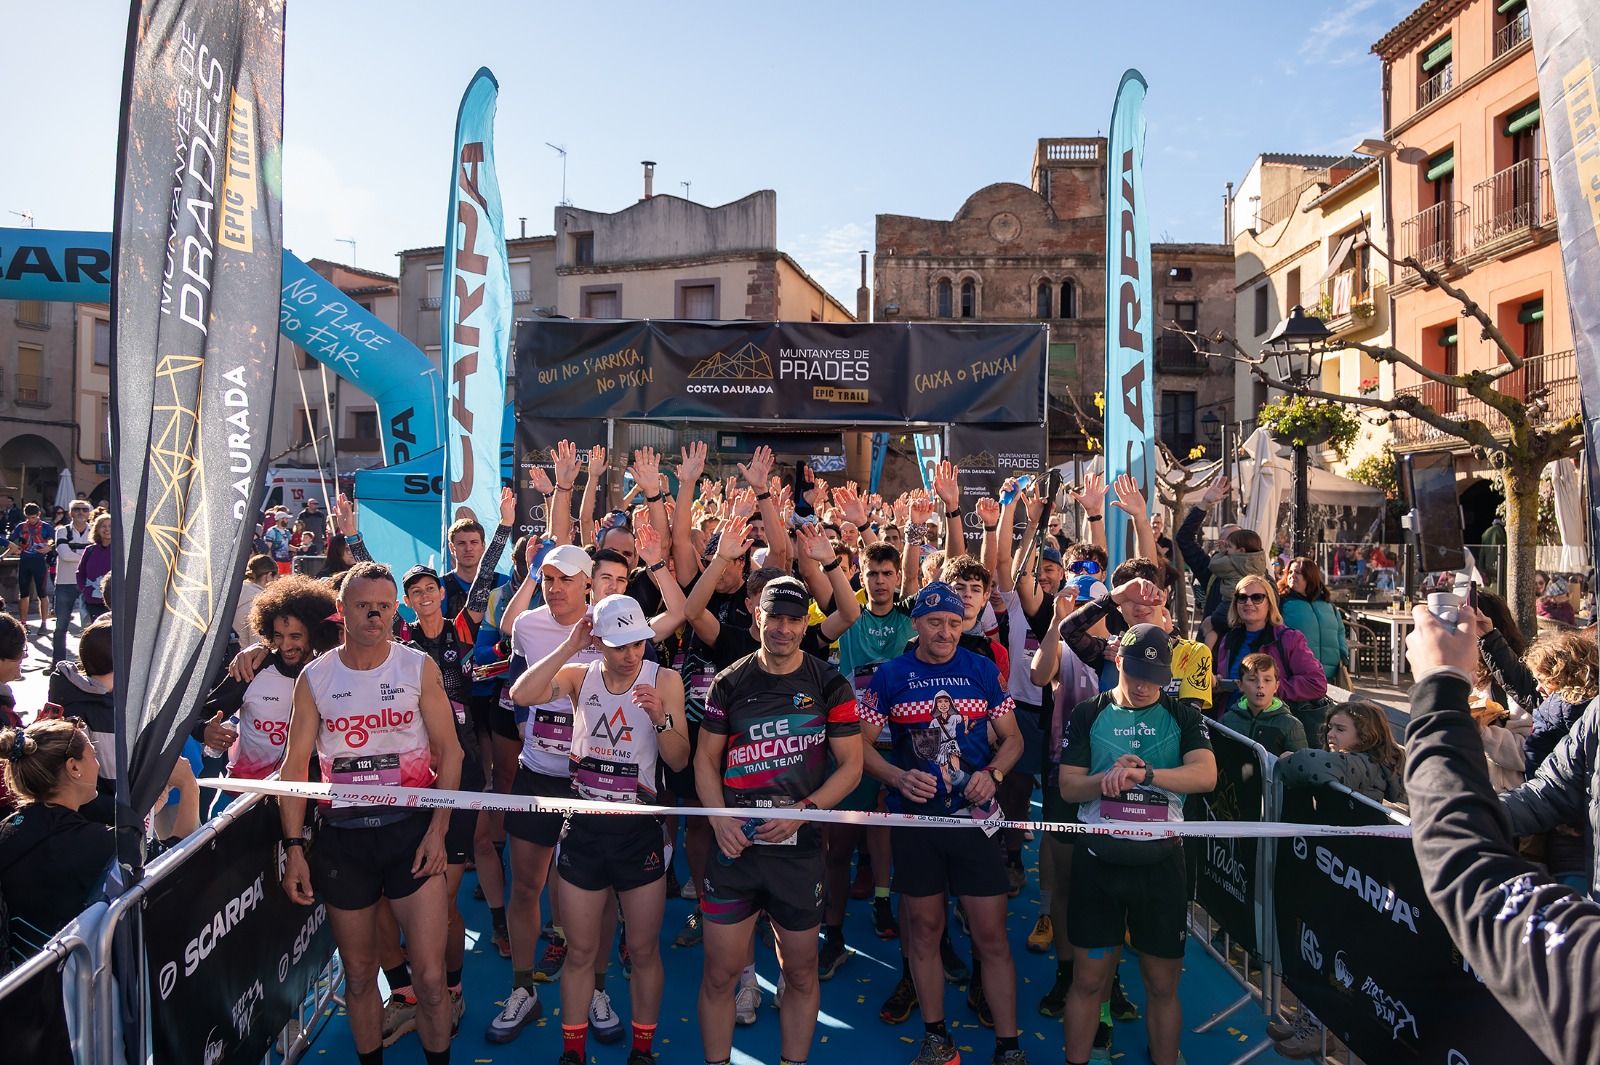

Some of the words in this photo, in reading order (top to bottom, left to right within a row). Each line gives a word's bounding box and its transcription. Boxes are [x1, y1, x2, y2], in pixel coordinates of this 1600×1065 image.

[181, 21, 196, 75] DE
[225, 188, 246, 244] EPIC
[0, 246, 111, 284] AR
[315, 302, 392, 351] PLACE
[780, 348, 850, 359] MUNTANYES
[853, 350, 870, 359] DE
[1119, 148, 1148, 560] CARPA
[538, 368, 558, 385] QUI
[619, 367, 655, 389] PISCA!
[780, 360, 870, 381] PRADES
[914, 370, 953, 394] CAIXA
[970, 354, 1017, 383] FAIXA!
[686, 384, 721, 394] COSTA
[722, 384, 774, 394] DAURADA
[815, 388, 835, 398] EPIC
[838, 391, 866, 401] TRAIL
[997, 458, 1040, 469] PRADES
[908, 677, 971, 689] BASTITANIA
[749, 719, 790, 741] CCE
[1113, 726, 1136, 736] trail
[356, 760, 372, 769] 1121
[600, 763, 615, 773] 1120
[743, 761, 771, 774] TRAIL
[773, 754, 803, 768] TEAM
[755, 799, 773, 808] 1069
[1126, 792, 1144, 802] 1050
[983, 819, 1028, 830] esportcat
[1034, 821, 1052, 832] Un
[1315, 845, 1418, 935] SCARPA
[184, 876, 265, 978] SCARPA
